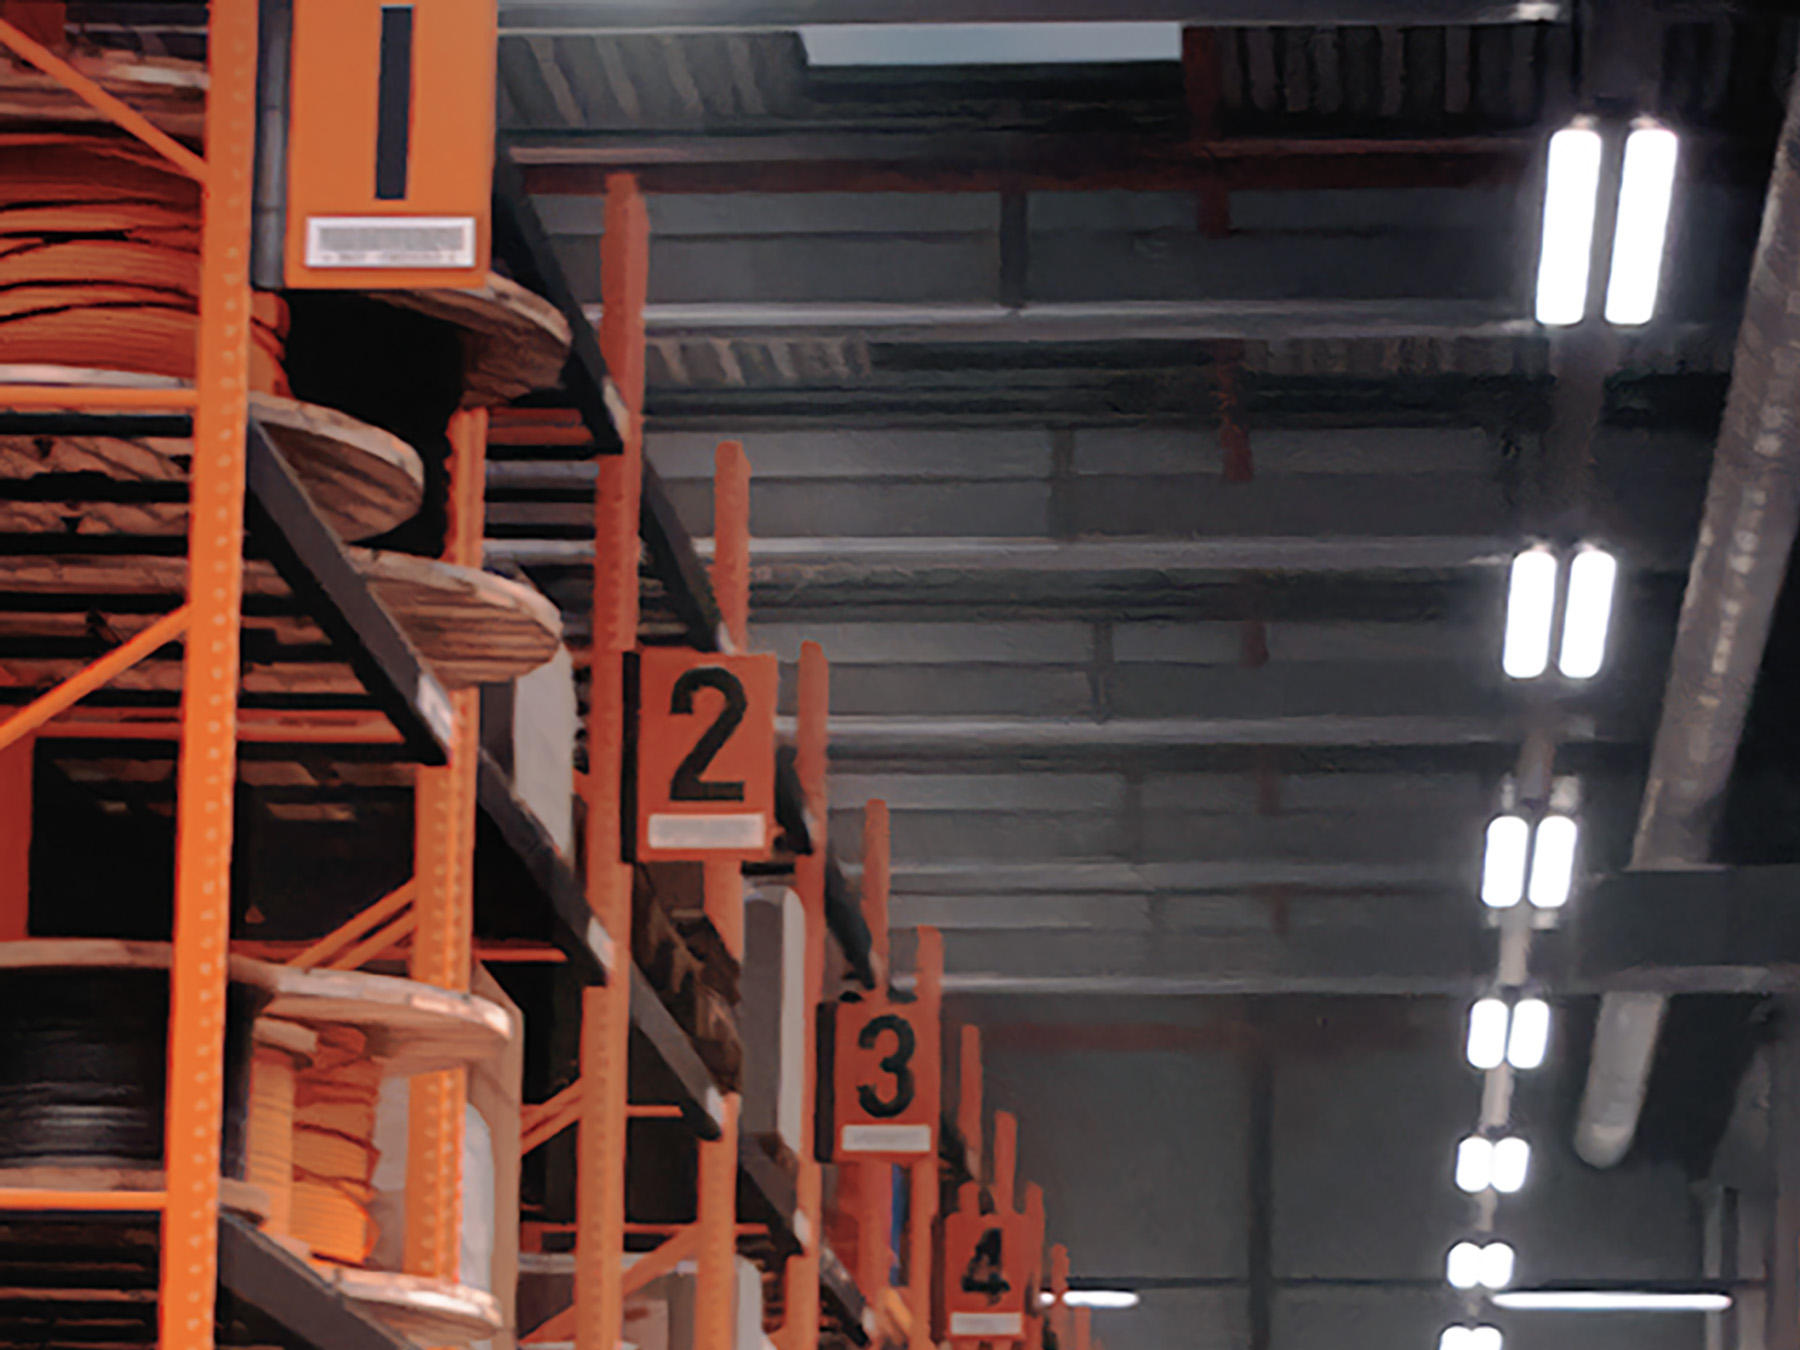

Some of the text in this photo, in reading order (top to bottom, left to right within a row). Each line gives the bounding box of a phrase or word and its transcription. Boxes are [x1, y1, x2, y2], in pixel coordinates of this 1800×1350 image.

[670, 667, 748, 802] 2
[857, 1014, 916, 1118] 3
[962, 1228, 1011, 1307] 4
